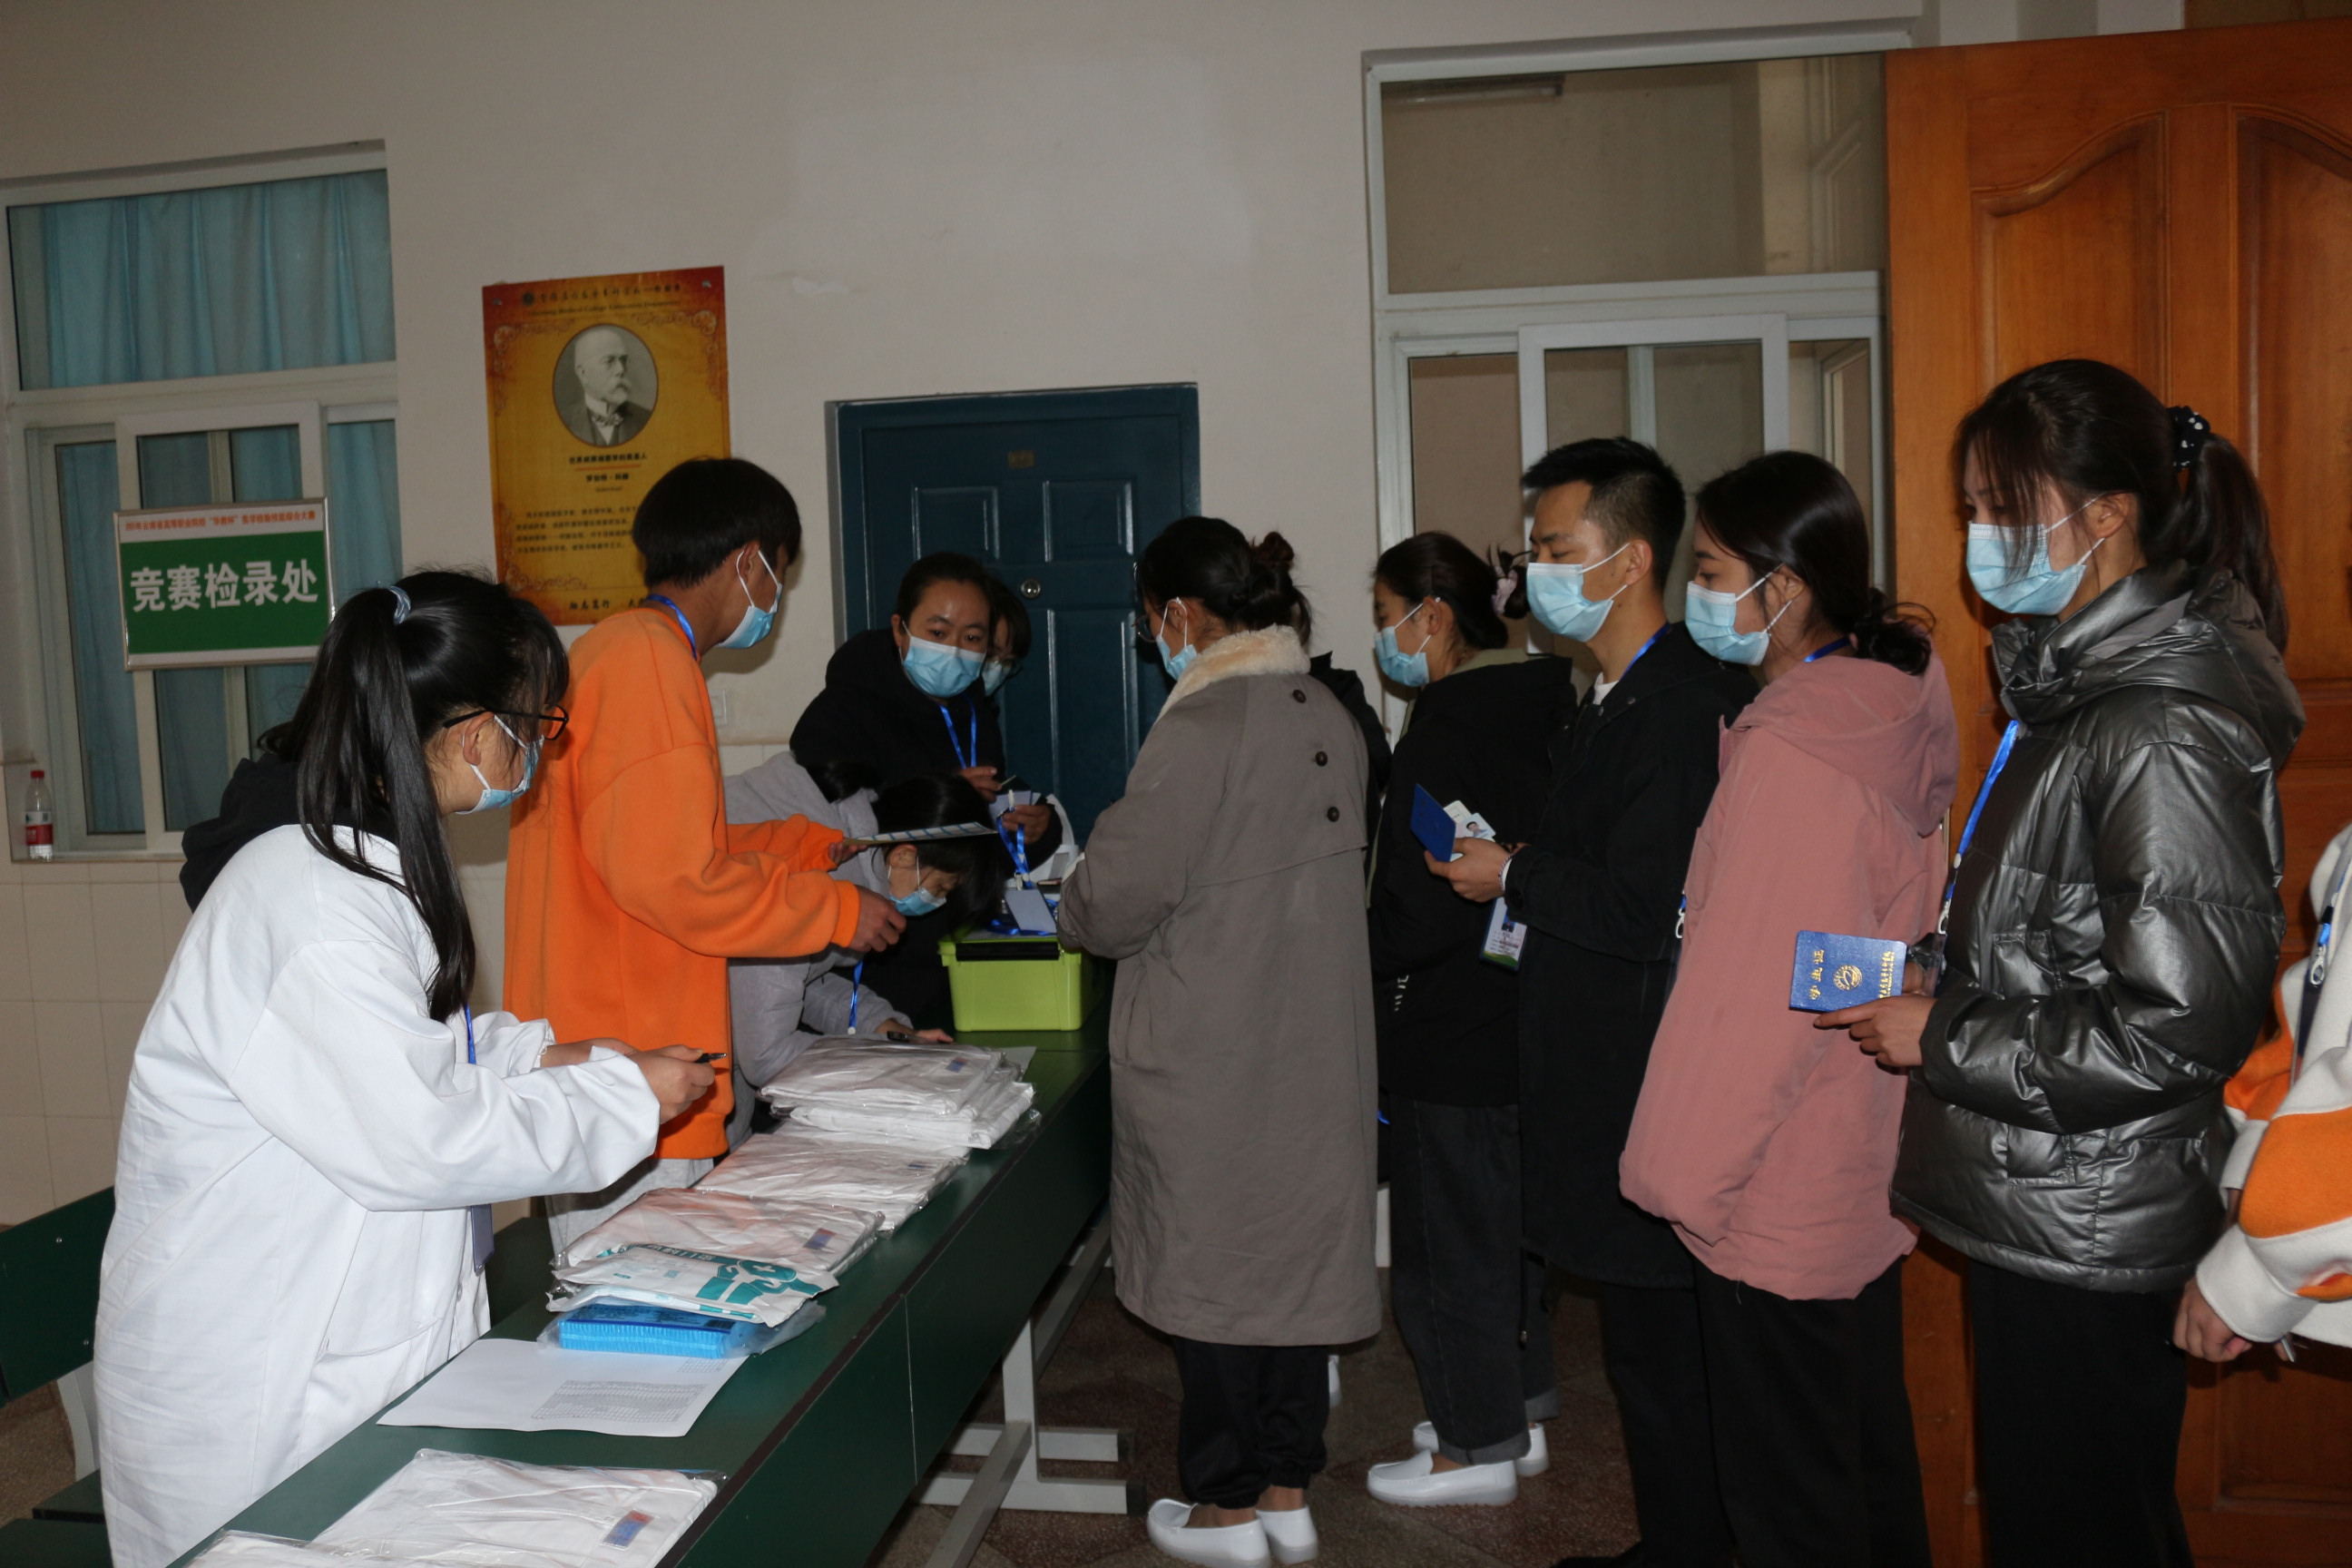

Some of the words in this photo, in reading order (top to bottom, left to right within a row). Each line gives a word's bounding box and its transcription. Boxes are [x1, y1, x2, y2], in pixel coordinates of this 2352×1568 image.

[130, 559, 318, 612] 竞赛检录处
[1807, 948, 1826, 1001] 学生证
